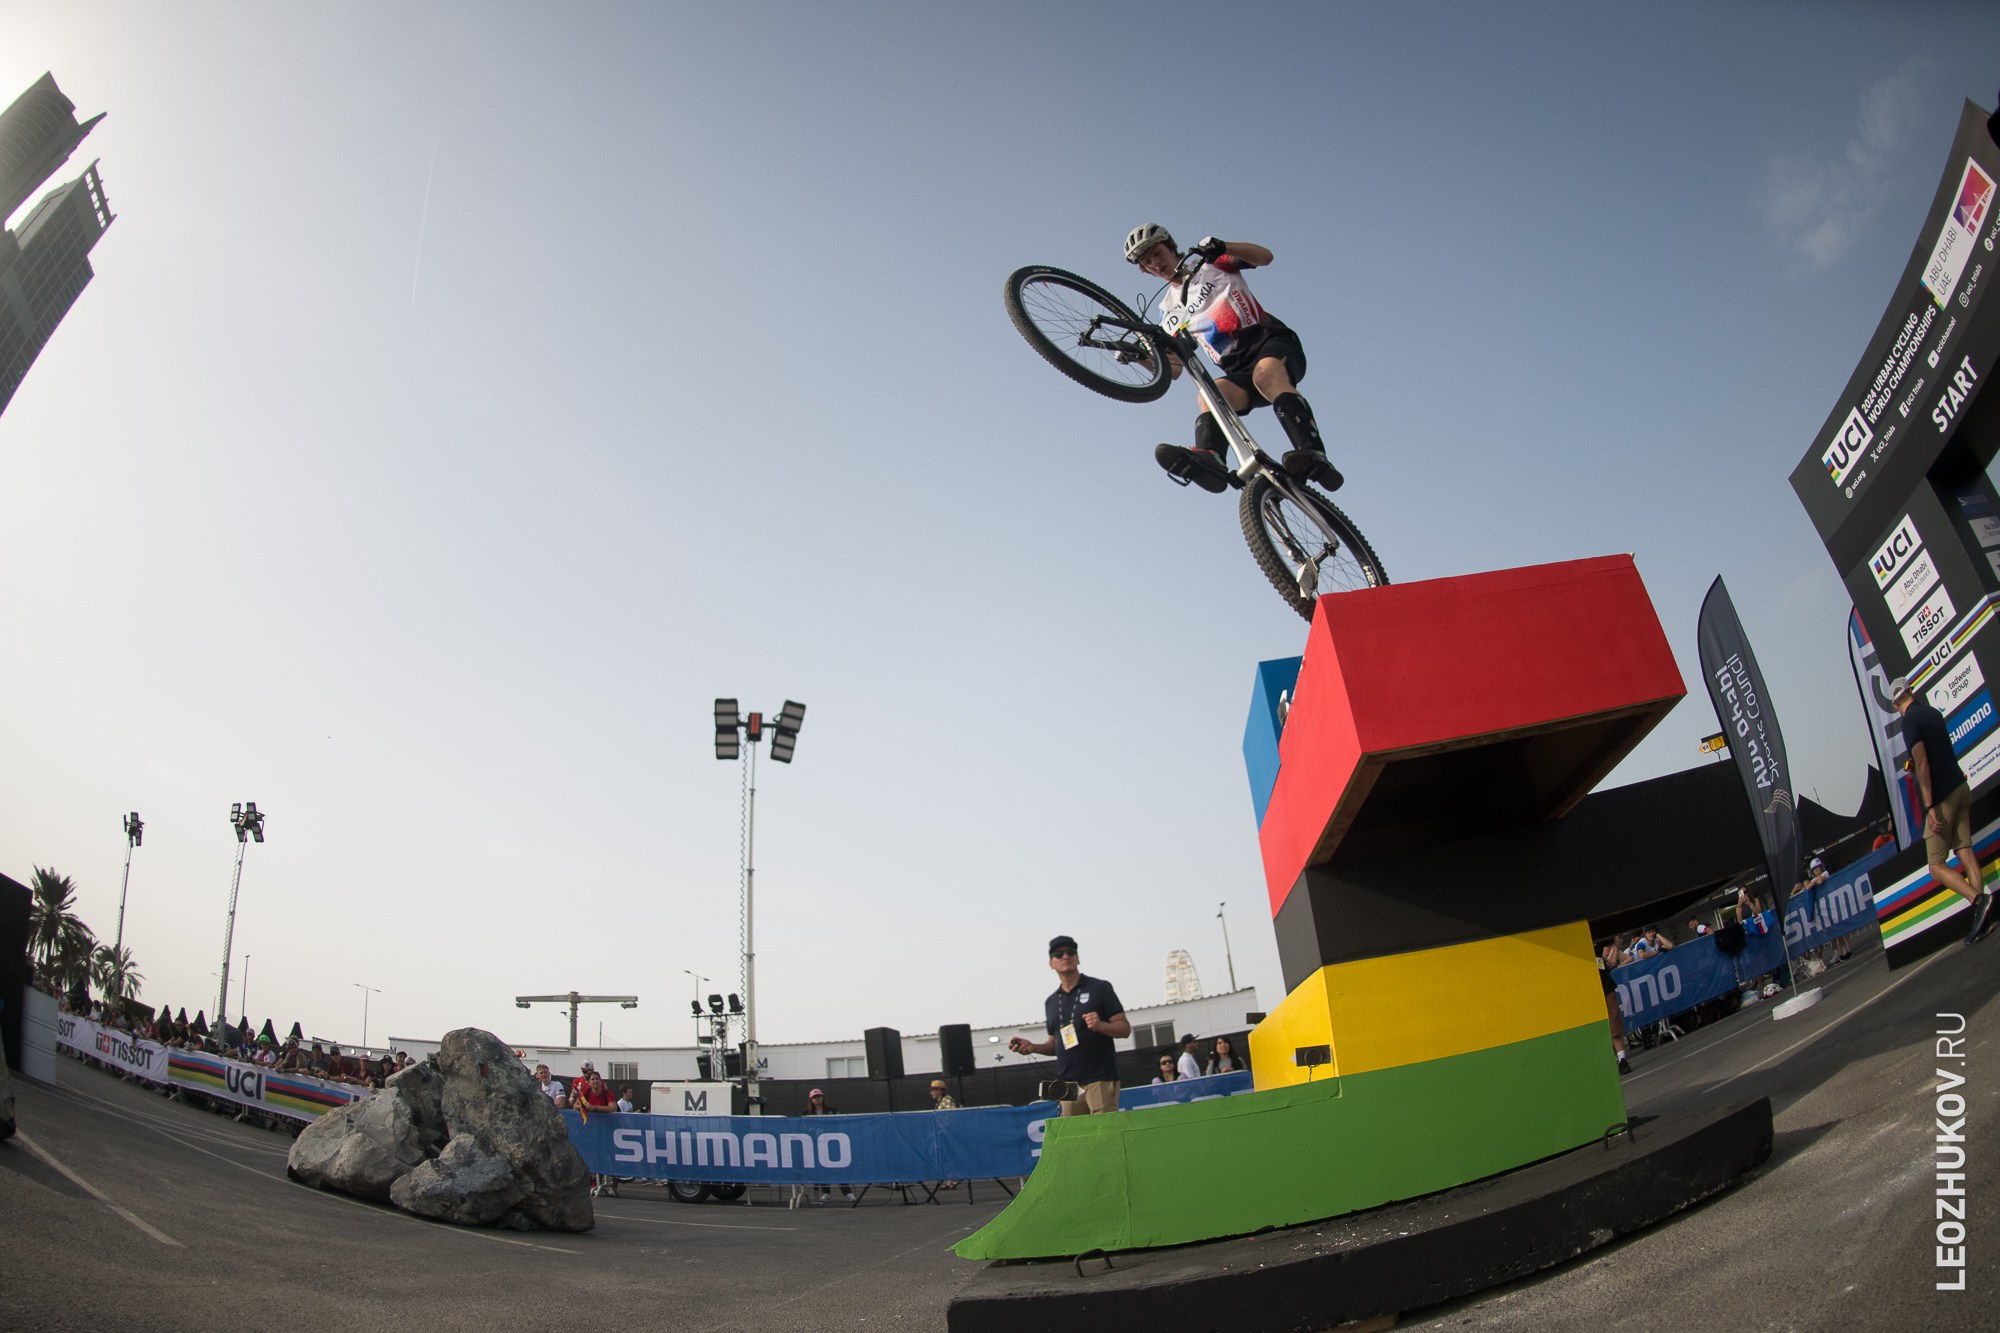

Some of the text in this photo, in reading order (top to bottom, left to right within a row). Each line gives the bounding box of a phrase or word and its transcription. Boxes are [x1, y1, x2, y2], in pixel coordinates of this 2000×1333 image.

[1928, 227, 1958, 285] ABU DHABI
[1937, 272, 1952, 296] UAE
[1965, 264, 1983, 295] uci_trials
[1187, 281, 1215, 316] OVAKIA
[1231, 290, 1253, 325] STRABAG
[1936, 317, 1957, 354] ucichannel
[1861, 312, 1919, 414] 2024 URBAN CYCLING
[1867, 304, 1937, 425] WORLD CHAMPIONSHIPS
[1906, 394, 1916, 407] UCI
[1932, 355, 1978, 433] START
[1830, 417, 1867, 470] UCI
[1852, 470, 1867, 490] uci.org
[1879, 527, 1914, 572] UCI
[1903, 562, 1928, 590] Abu Dhabi
[1912, 606, 1944, 643] TISSOT
[1931, 642, 1951, 666] UCI
[1948, 665, 1972, 690] tadweer
[1951, 678, 1969, 698] group
[1715, 664, 1771, 789] Abu Dhabi
[1726, 653, 1780, 783] Sports Council
[1949, 702, 1992, 745] SHIMANO
[110, 1038, 154, 1070] TISSOT
[224, 1065, 263, 1100] UCI
[612, 1128, 853, 1169] SHIMANO
